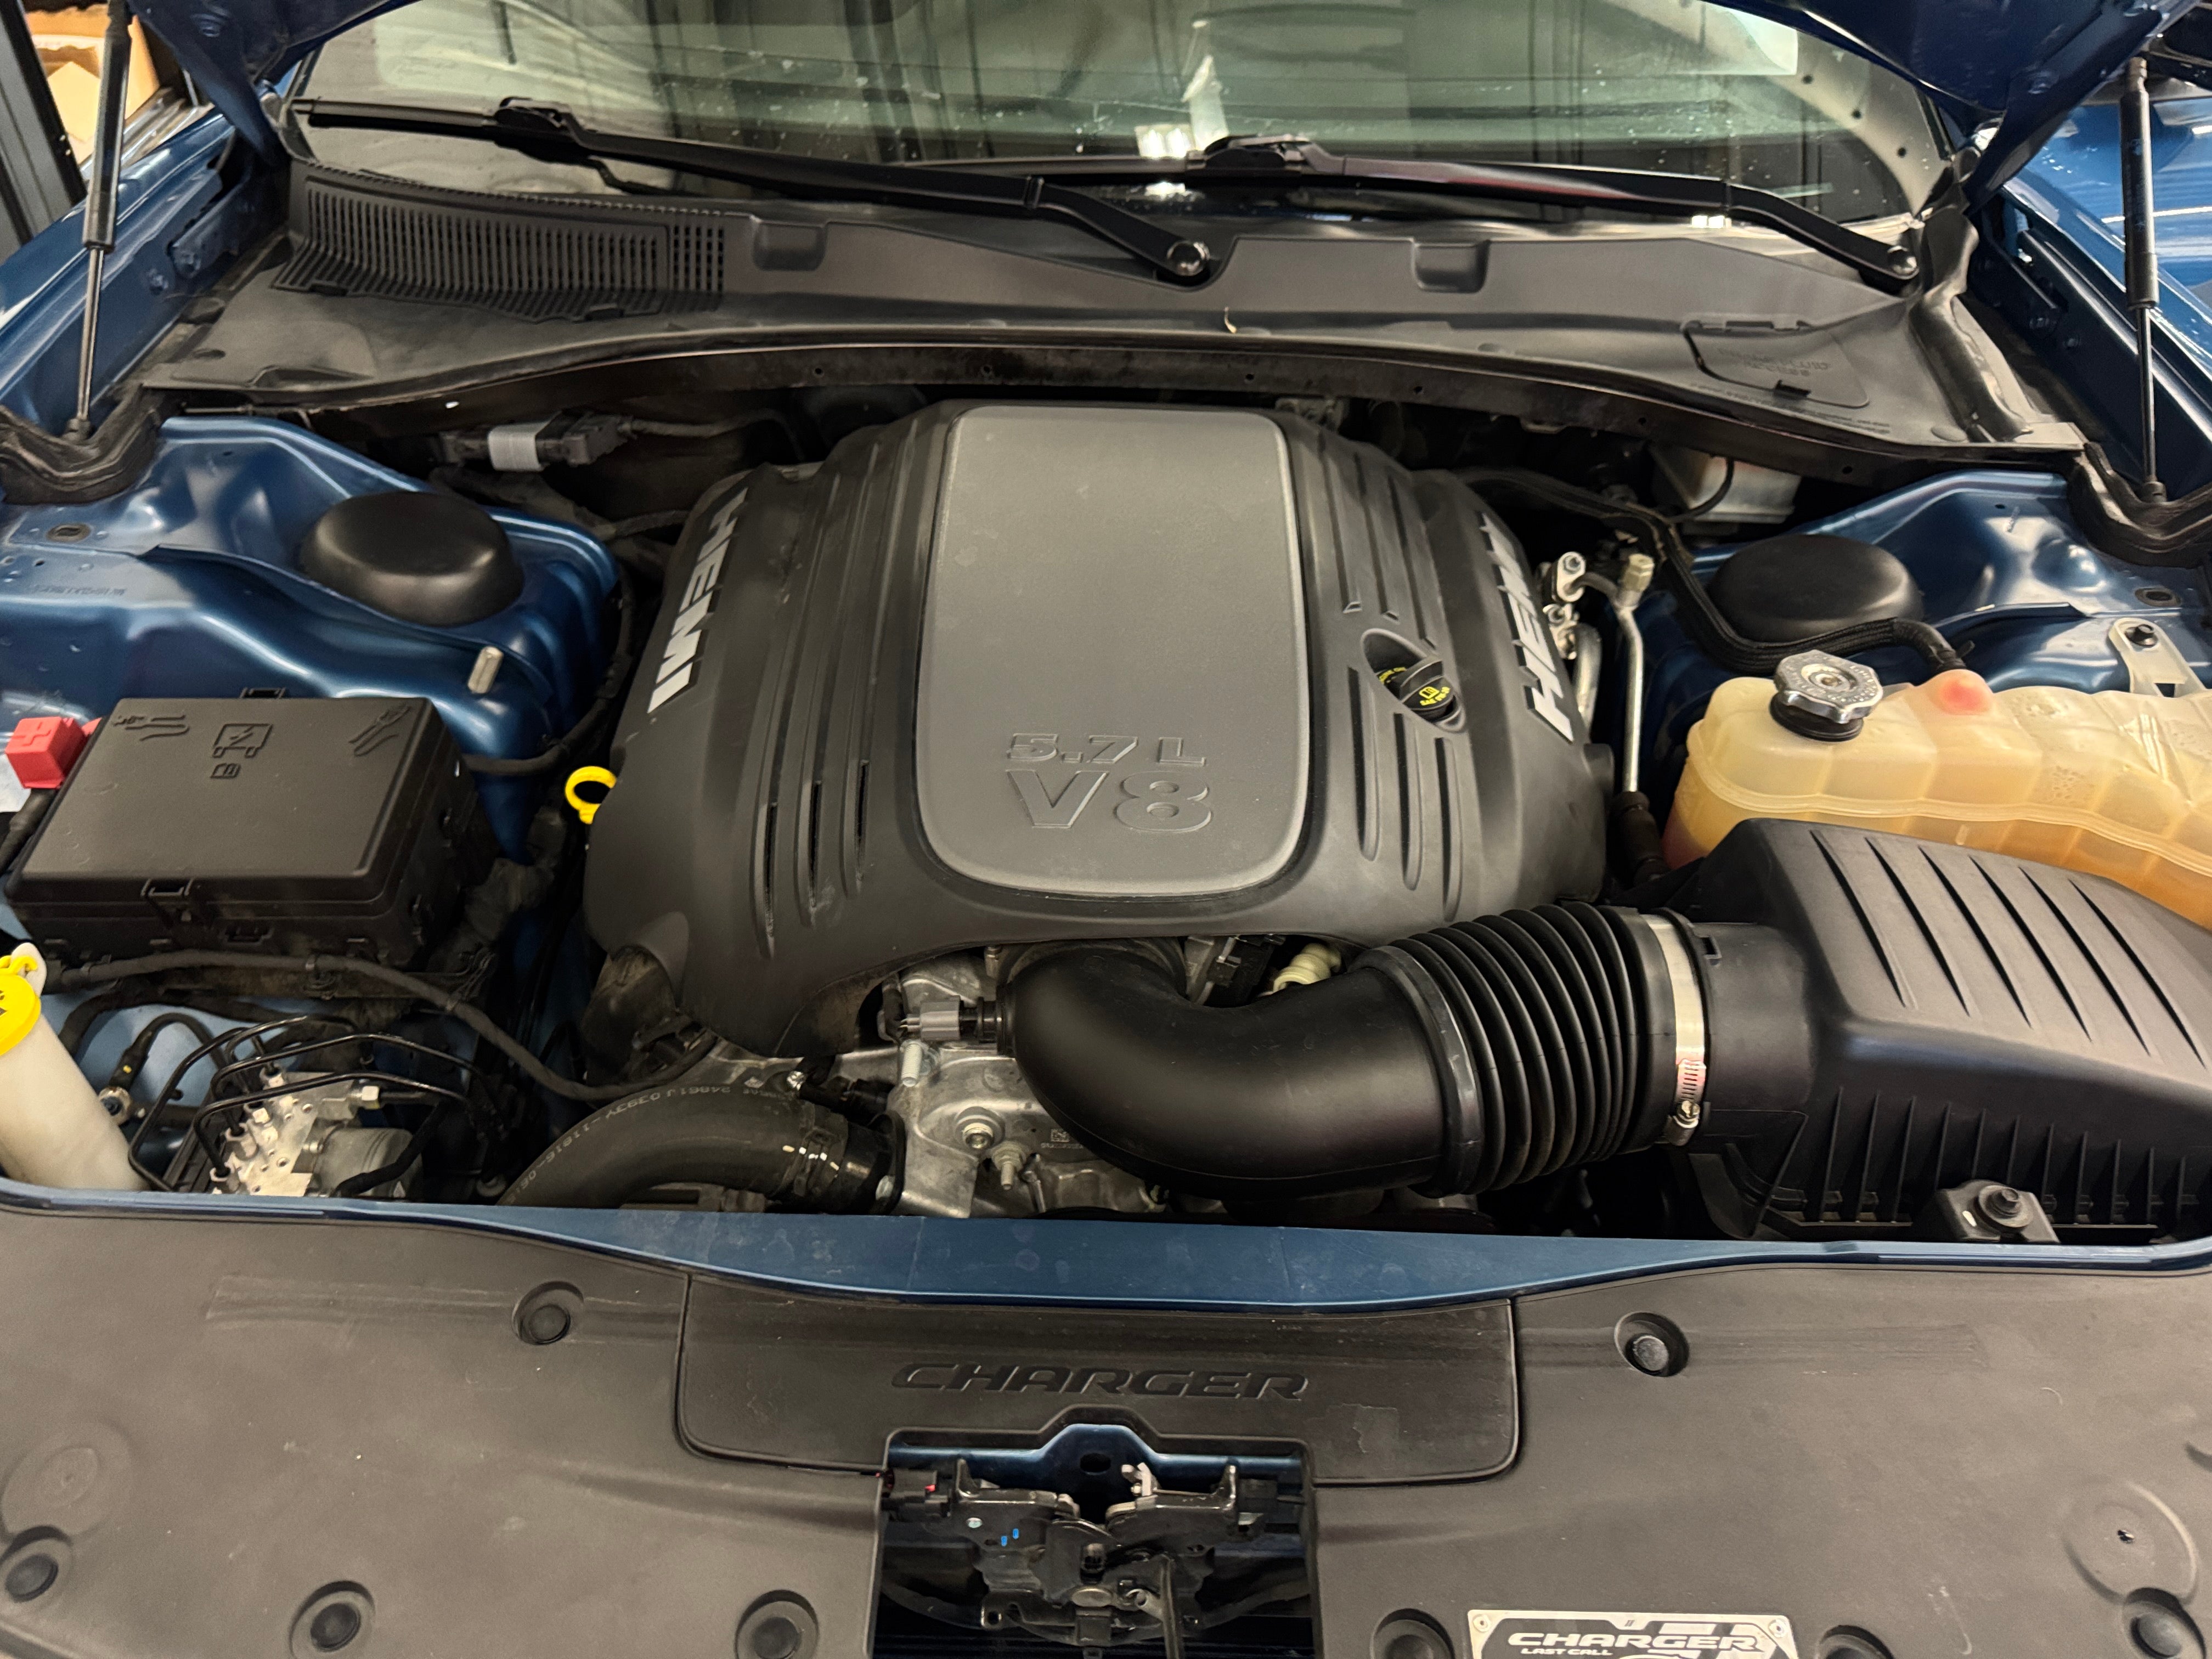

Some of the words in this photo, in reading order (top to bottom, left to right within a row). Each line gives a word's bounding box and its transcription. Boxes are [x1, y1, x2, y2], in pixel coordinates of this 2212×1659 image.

[647, 487, 748, 714] HEMI
[1482, 513, 1573, 742] HEMI
[1006, 733, 1138, 764] 5.7
[1157, 737, 1207, 767] L
[1005, 769, 1214, 833] V8
[890, 1362, 1309, 1401] CHARGER
[1508, 1633, 1757, 1650] CHARGER
